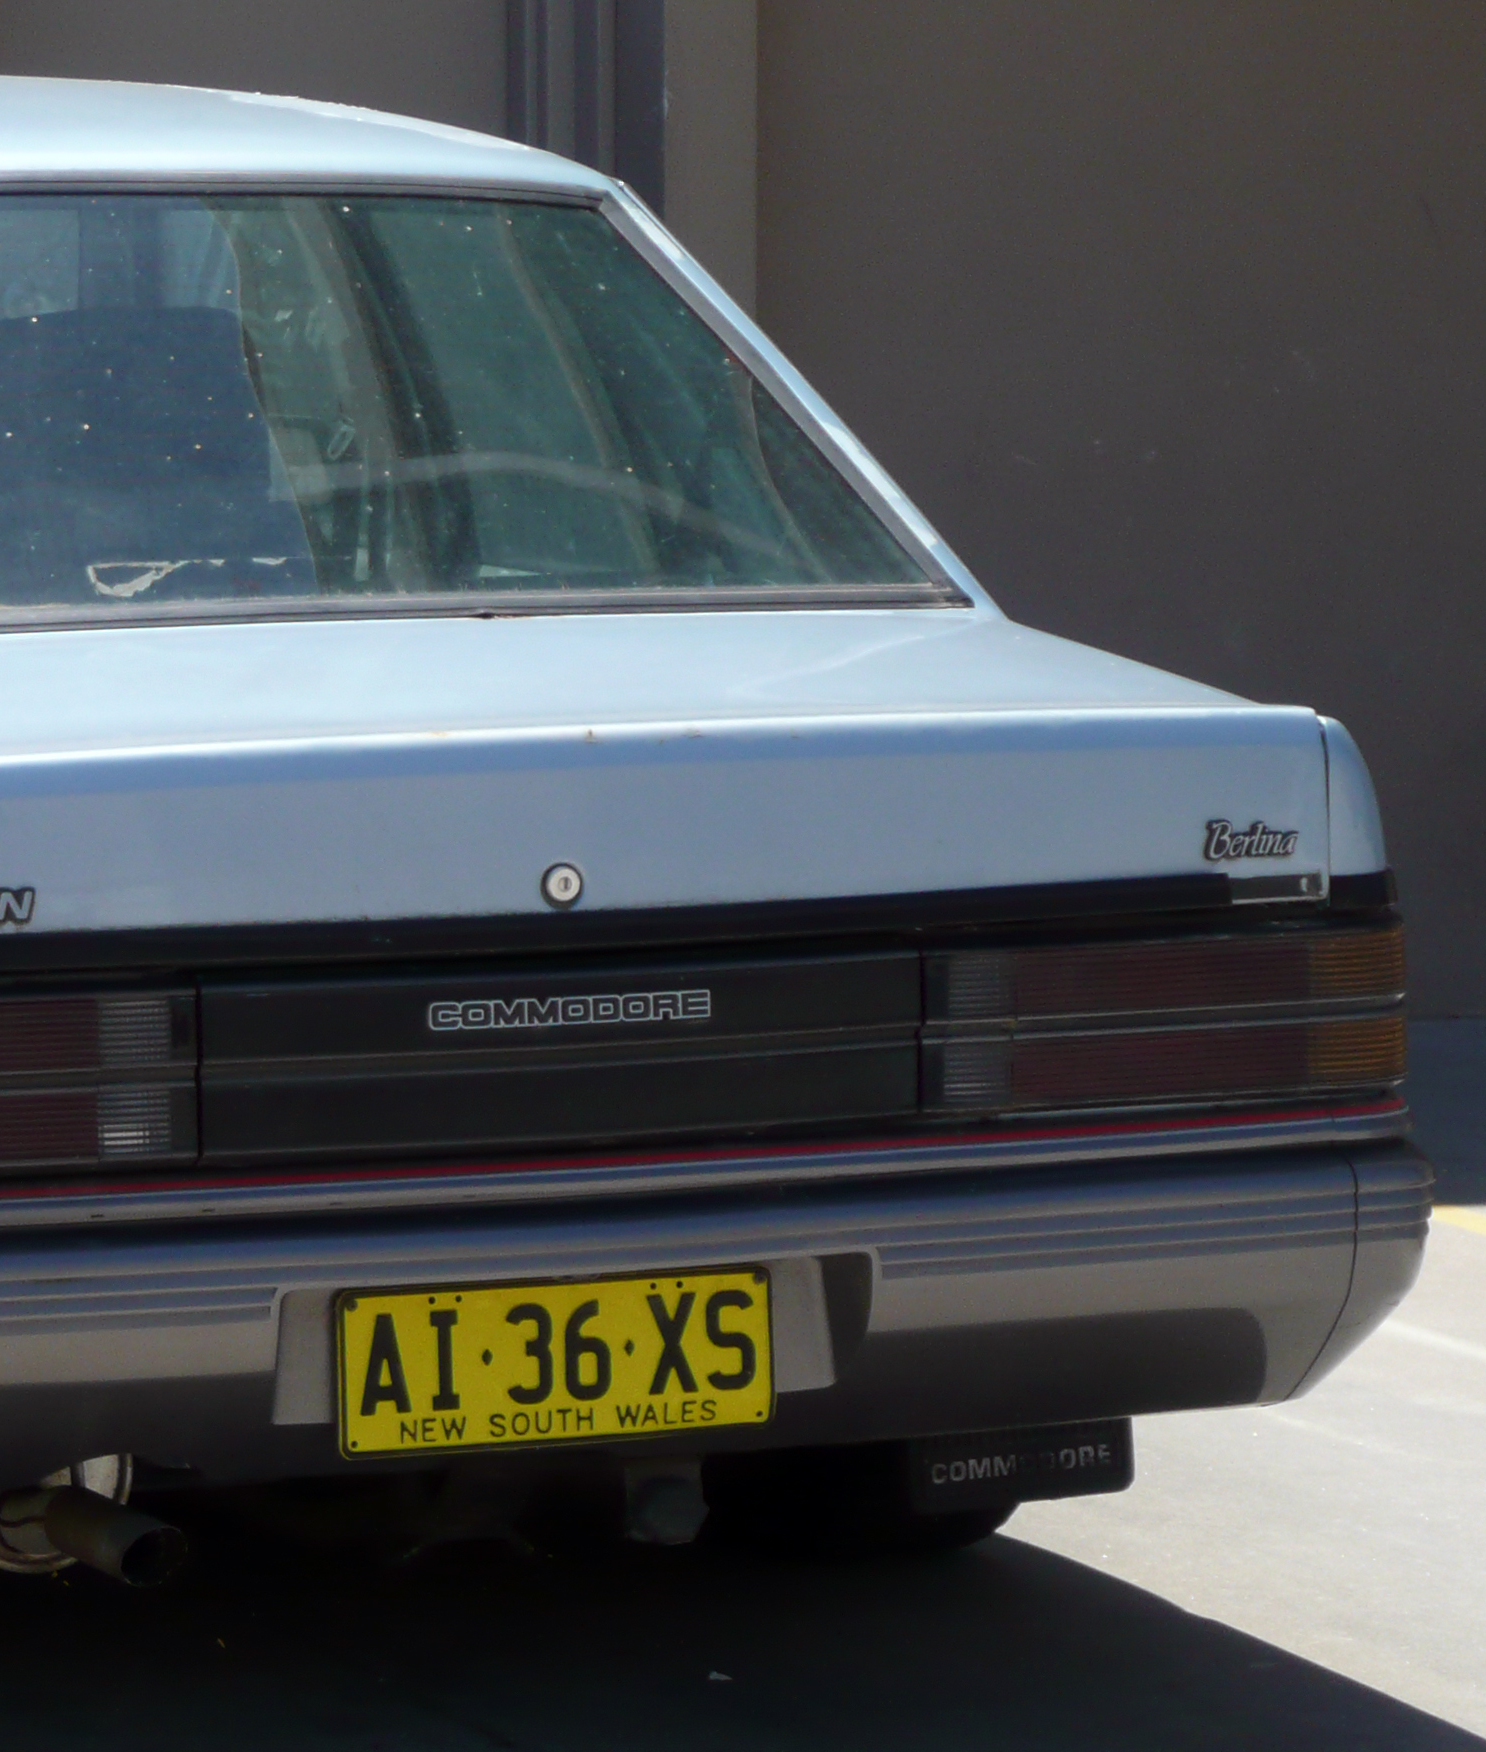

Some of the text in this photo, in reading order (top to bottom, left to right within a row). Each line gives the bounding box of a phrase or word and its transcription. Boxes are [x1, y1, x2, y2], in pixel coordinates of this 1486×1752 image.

[1204, 819, 1299, 862] Berlina
[428, 989, 711, 1031] COMMODORE
[400, 1399, 718, 1444] NEW SOUTH WALES
